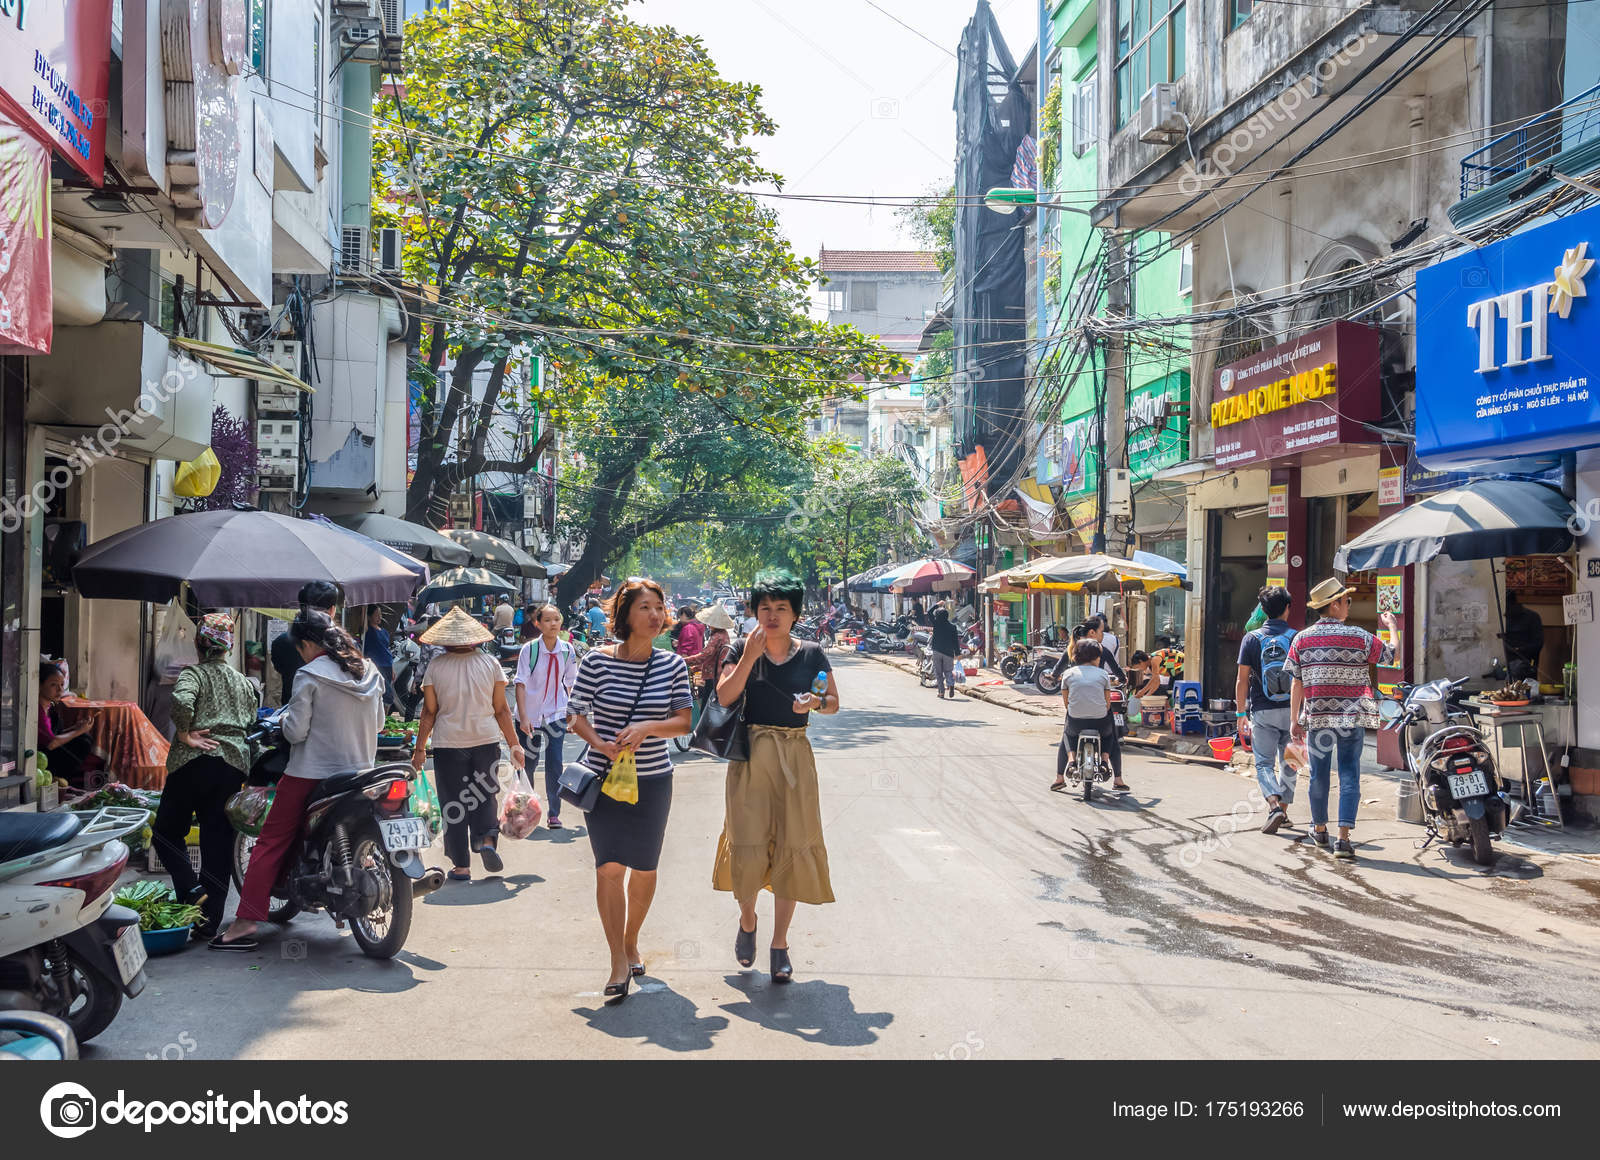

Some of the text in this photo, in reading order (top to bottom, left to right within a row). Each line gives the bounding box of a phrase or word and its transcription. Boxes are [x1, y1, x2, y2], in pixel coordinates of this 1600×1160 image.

[1467, 281, 1553, 374] TH
[1476, 395, 1491, 406] CÔNG
[1492, 394, 1499, 403] TY
[1499, 389, 1507, 401] CỔ
[1543, 383, 1558, 394] THỰC
[1578, 377, 1587, 386] TH
[1504, 401, 1512, 413] SỐ
[1546, 395, 1560, 406] LIÊN
[1567, 391, 1576, 402] HÀ
[1577, 389, 1589, 402] NỘI
[1211, 393, 1250, 429] PIZZA
